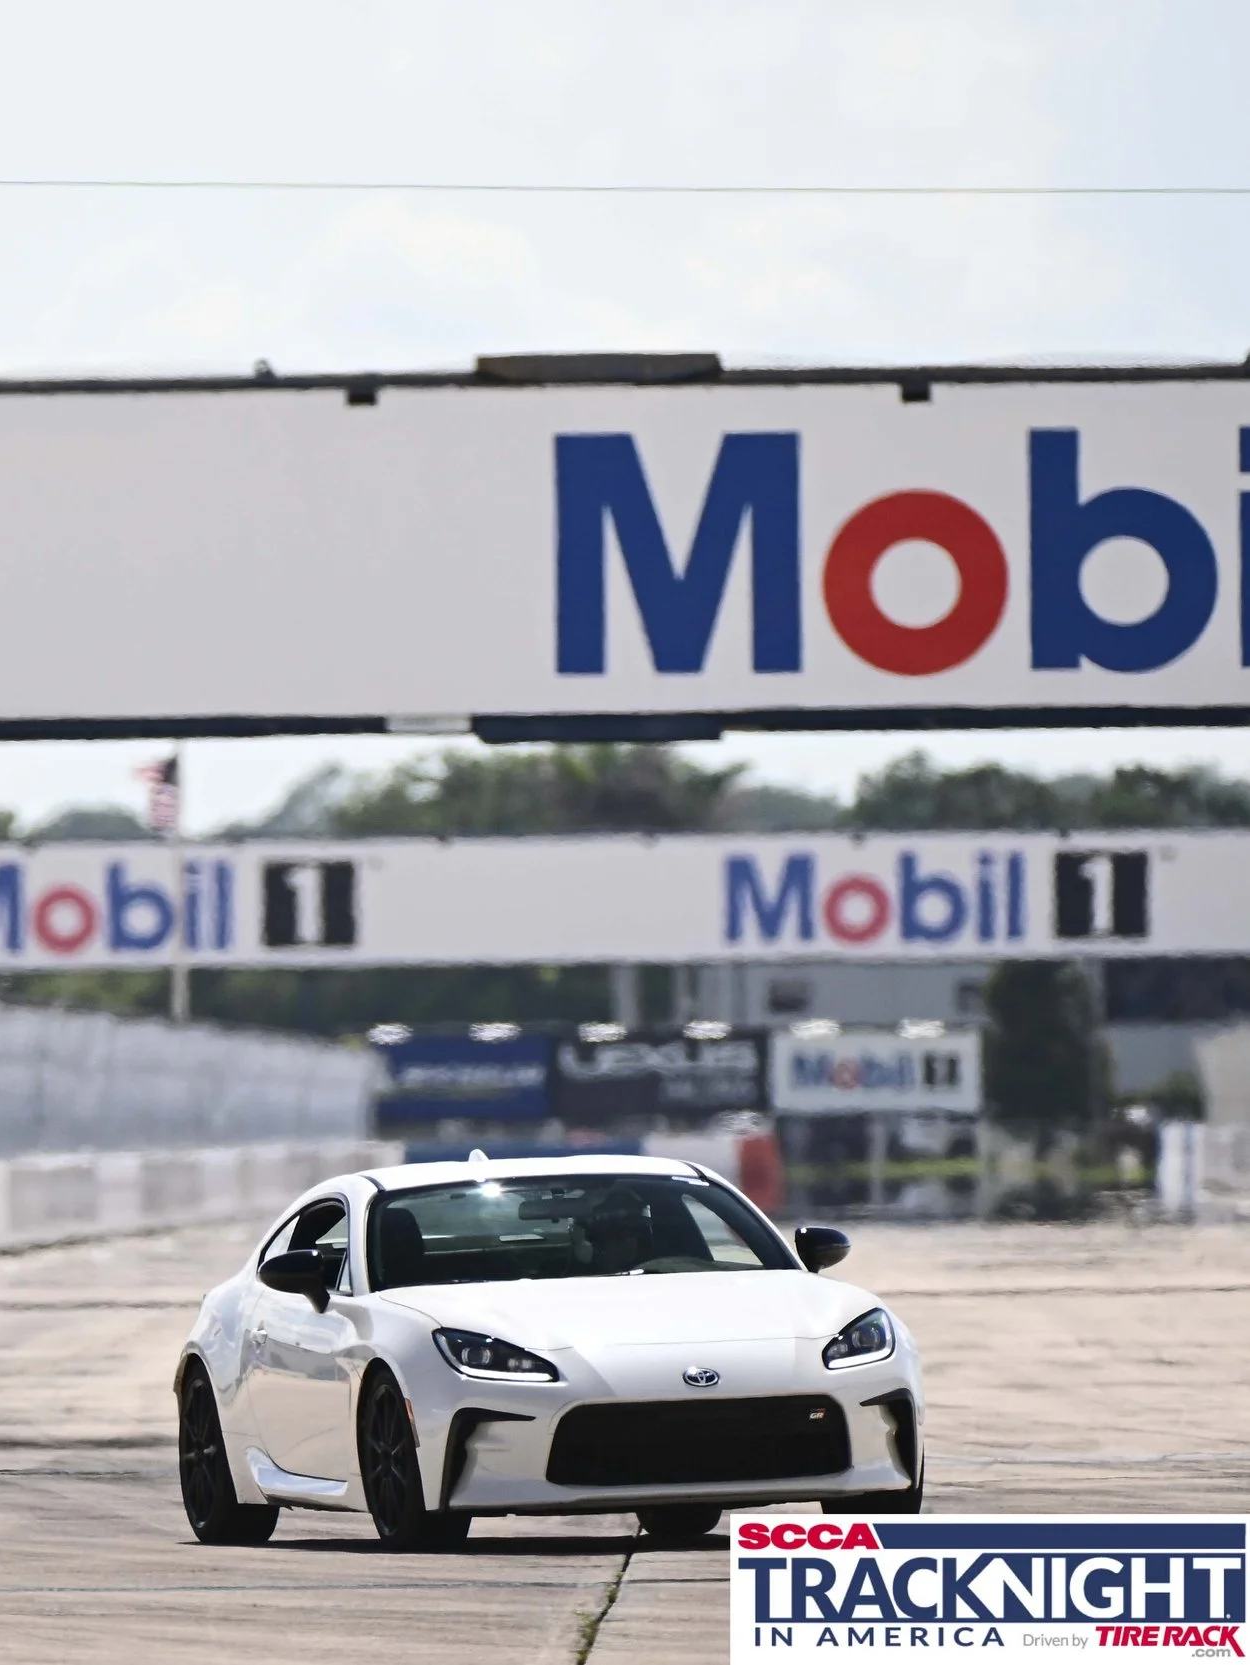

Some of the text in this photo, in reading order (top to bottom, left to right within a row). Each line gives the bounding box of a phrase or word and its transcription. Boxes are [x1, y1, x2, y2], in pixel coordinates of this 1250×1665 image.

[553, 425, 1250, 677] Mob
[724, 848, 1026, 944] Mobil
[793, 1052, 915, 1091] Mobil
